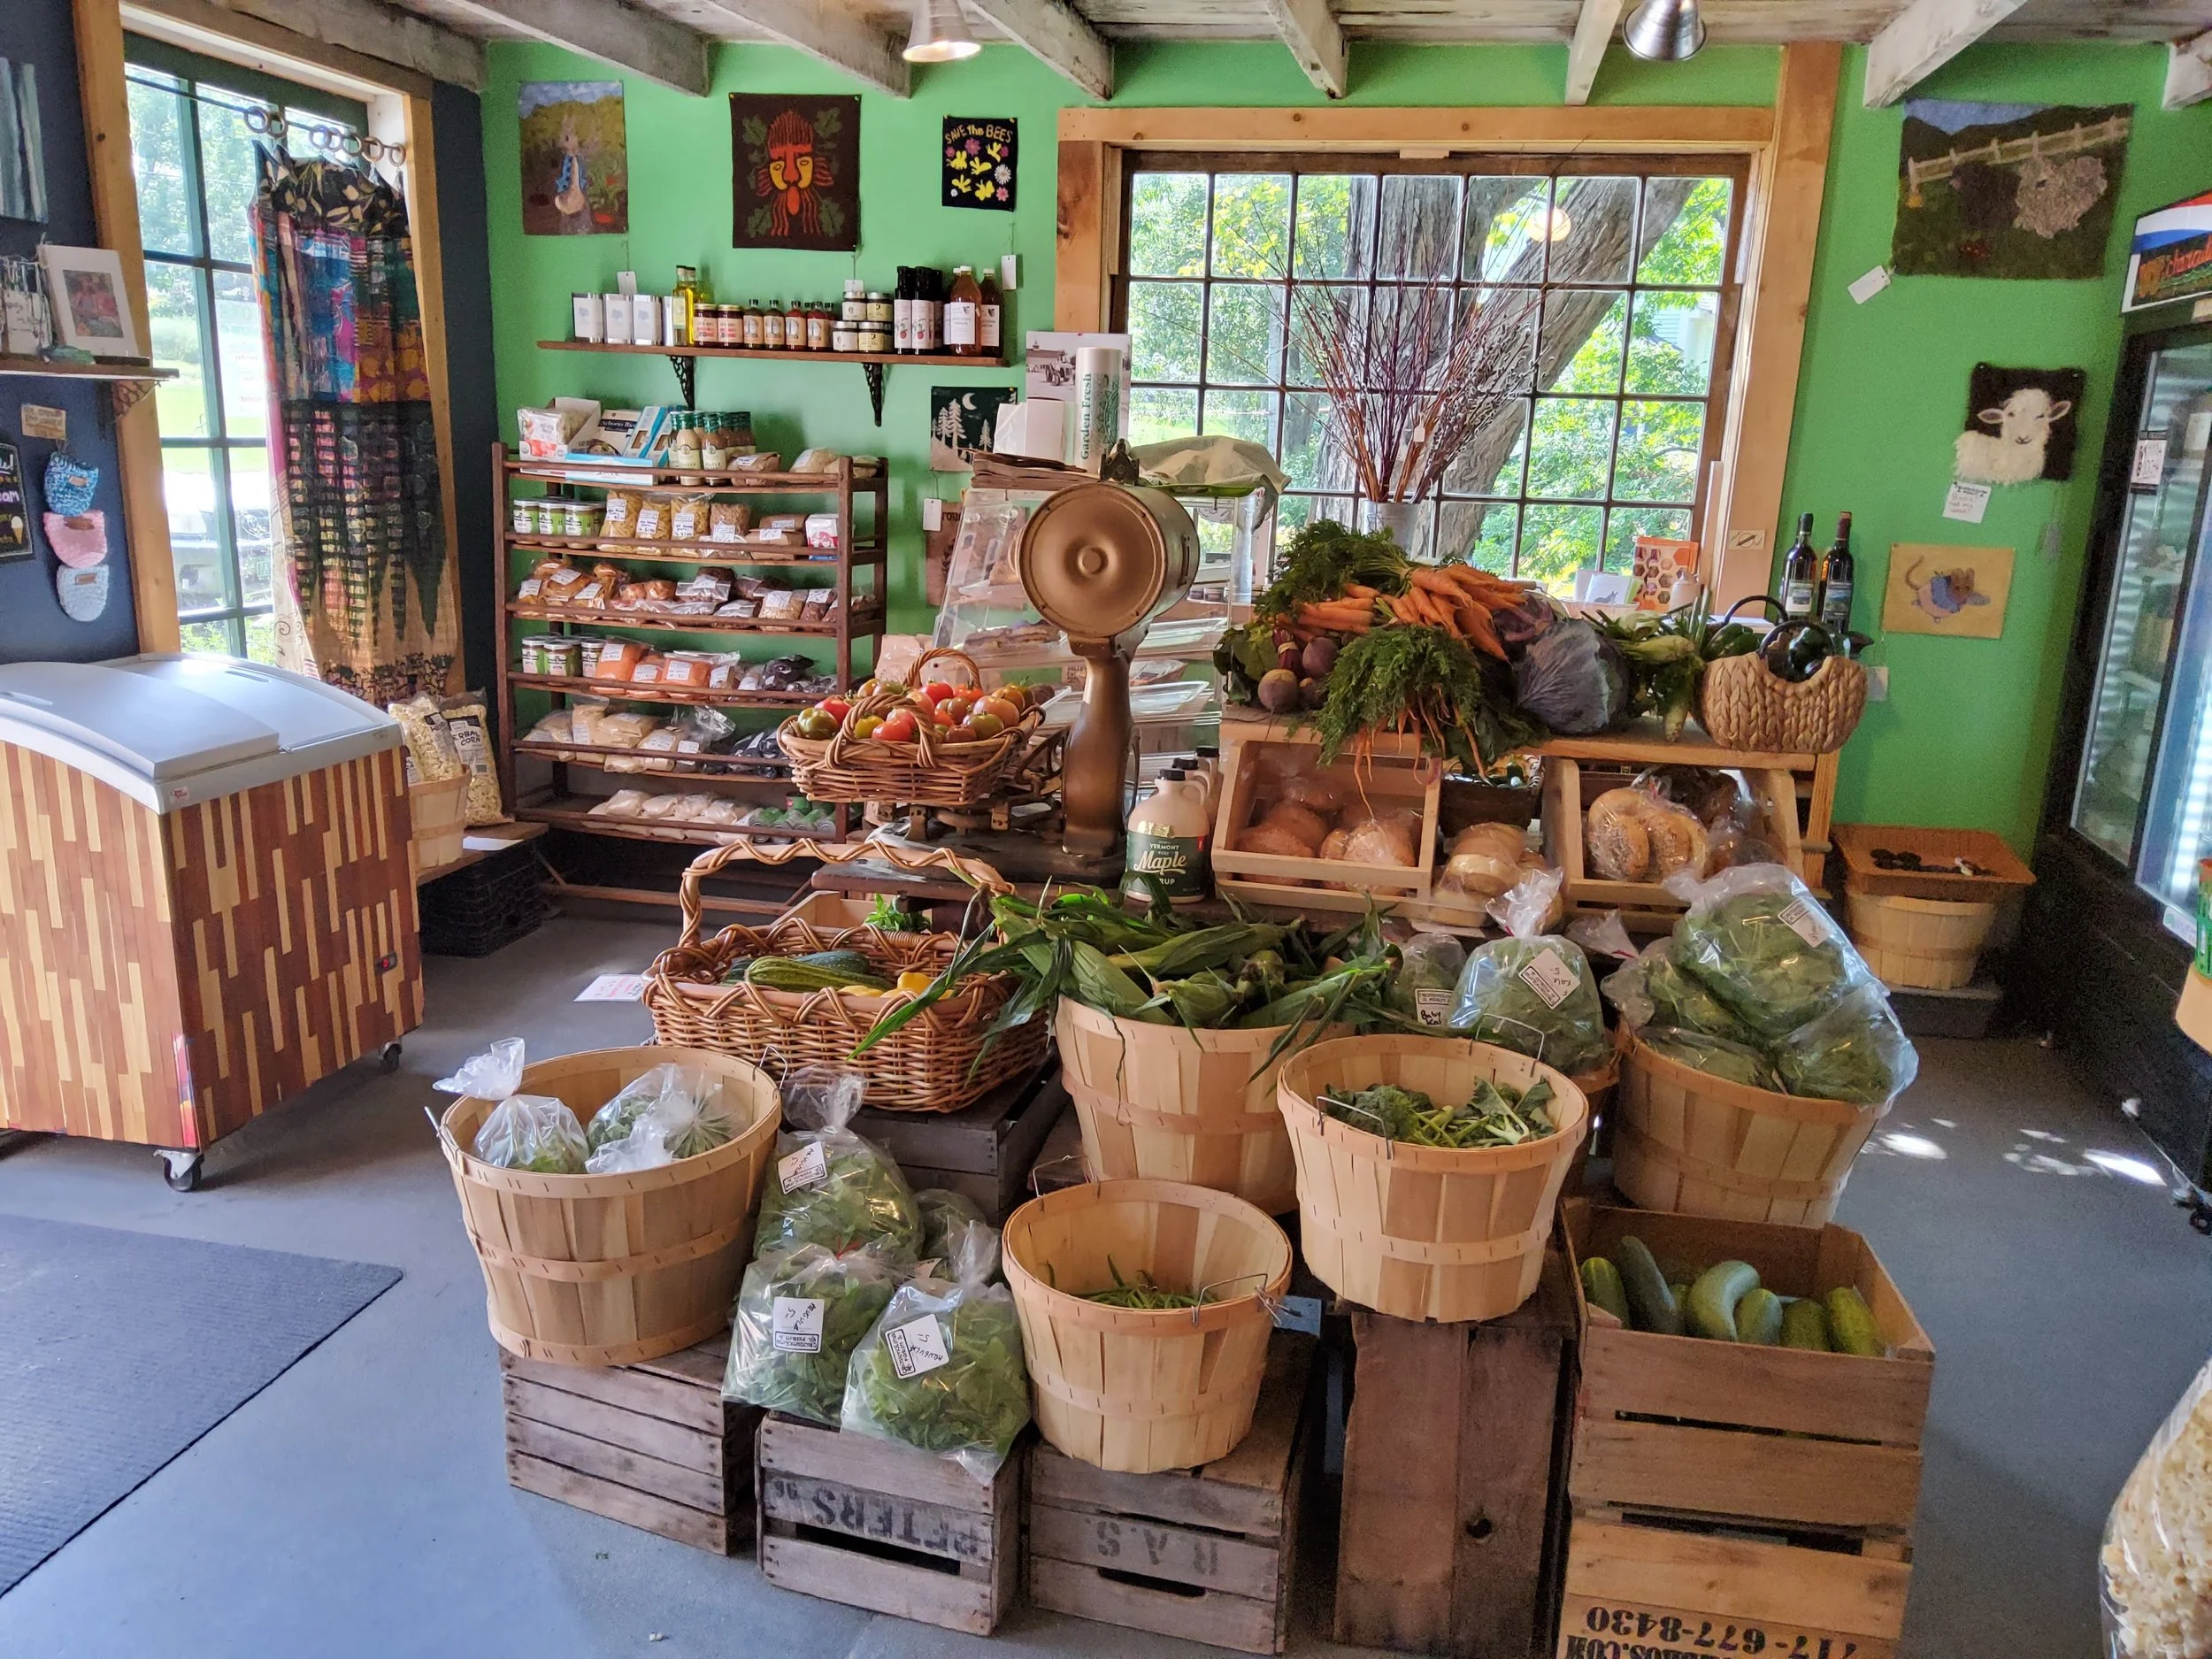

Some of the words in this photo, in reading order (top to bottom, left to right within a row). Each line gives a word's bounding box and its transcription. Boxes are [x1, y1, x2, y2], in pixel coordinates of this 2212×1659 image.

[945, 125, 967, 144] SAVE
[987, 124, 1013, 142] BEES
[1082, 373, 1092, 408] Fresh
[1081, 414, 1090, 459] Garden
[1133, 850, 1187, 875] Maple
[909, 1345, 944, 1361] ARUGULA
[811, 1486, 979, 1555] PETERS
